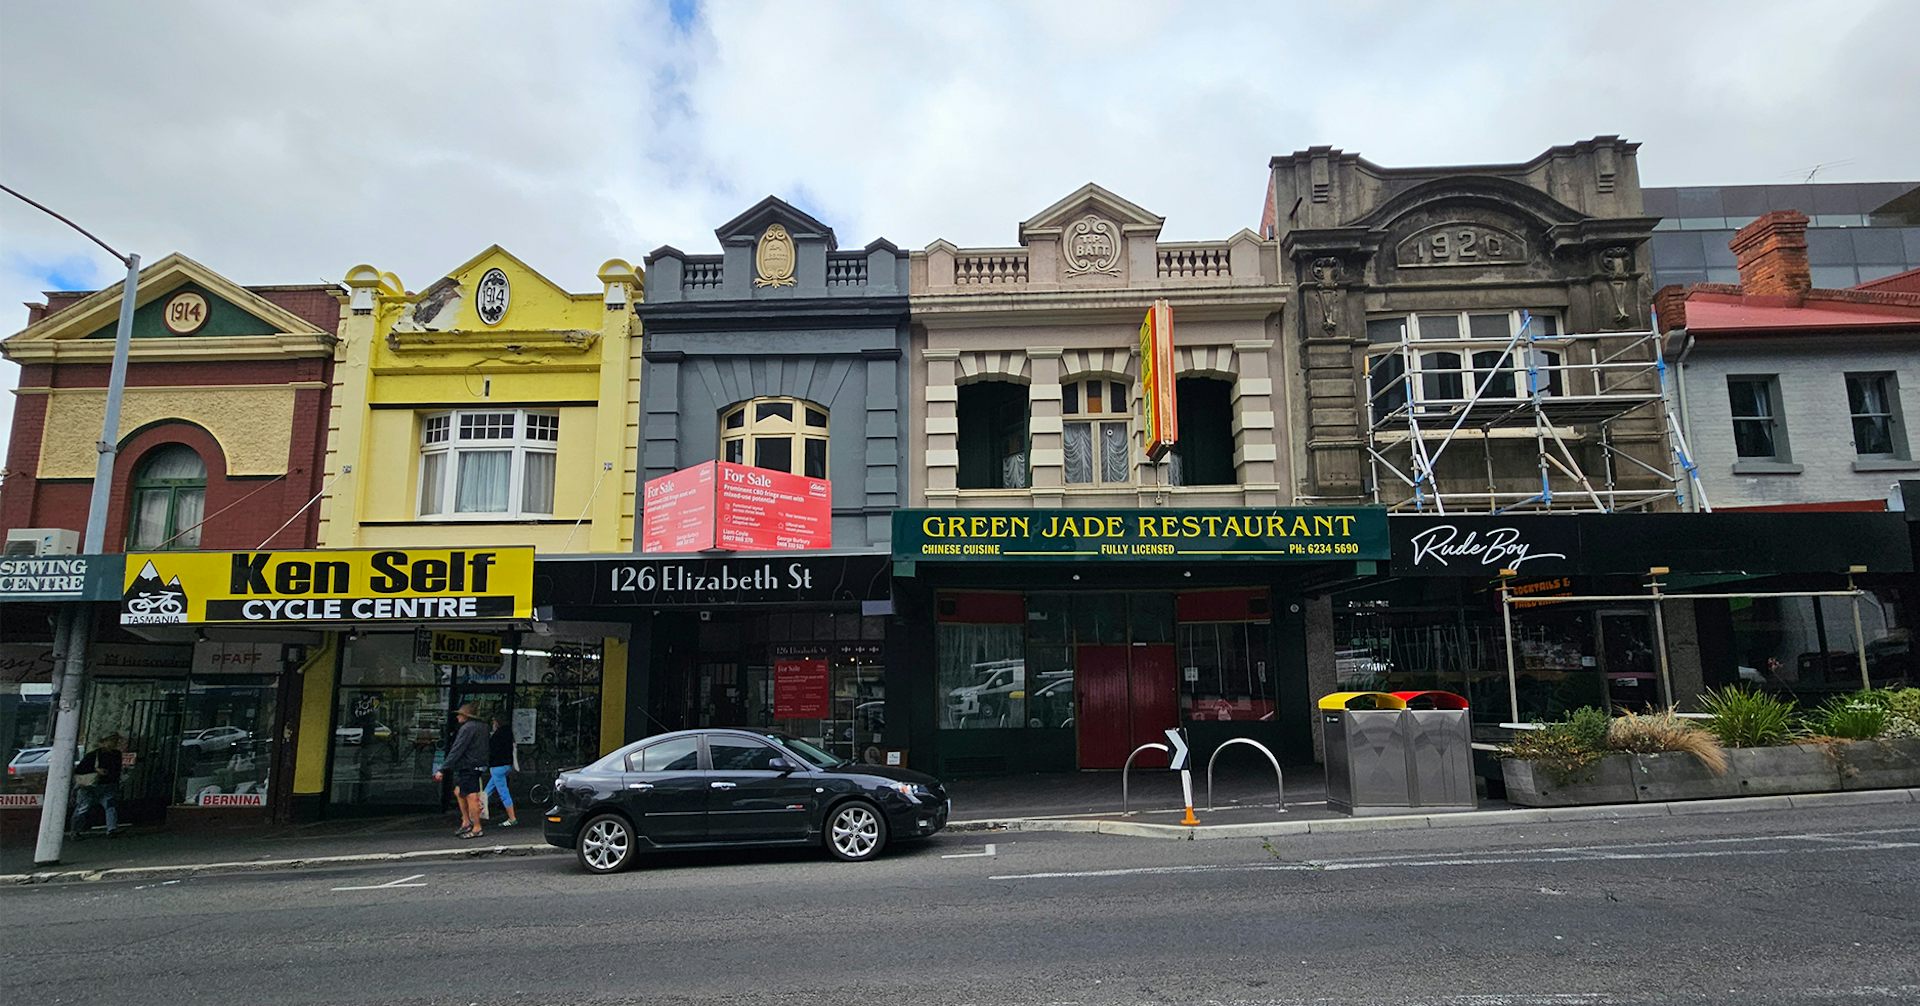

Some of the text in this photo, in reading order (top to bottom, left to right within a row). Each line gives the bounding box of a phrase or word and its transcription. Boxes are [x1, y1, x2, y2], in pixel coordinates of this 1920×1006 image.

[1418, 231, 1502, 257] 1920
[481, 287, 504, 306] 1914
[170, 302, 201, 322] 1914
[724, 468, 745, 483] For
[747, 472, 771, 488] Sale
[647, 480, 675, 498] For Sale
[922, 515, 1356, 538] GREEN JADE RESTAURANT
[922, 544, 1000, 555] CHINESE CUISINE
[1101, 544, 1175, 555] FULLY LICENSED
[1289, 543, 1359, 554] PH: 6234 5690
[1411, 525, 1567, 571] Rude Boy
[0, 559, 88, 575] SEWING
[230, 551, 496, 595] Ken Self
[0, 575, 85, 591] CENTRE
[611, 562, 812, 592] 126 Elizabeth St
[242, 597, 477, 620] CYCLE CENTRE
[128, 615, 180, 624] TASMANIA
[435, 633, 465, 652] Ken
[469, 637, 498, 655] Self
[211, 653, 262, 664] PFAFF
[203, 795, 261, 805] BERNINA
